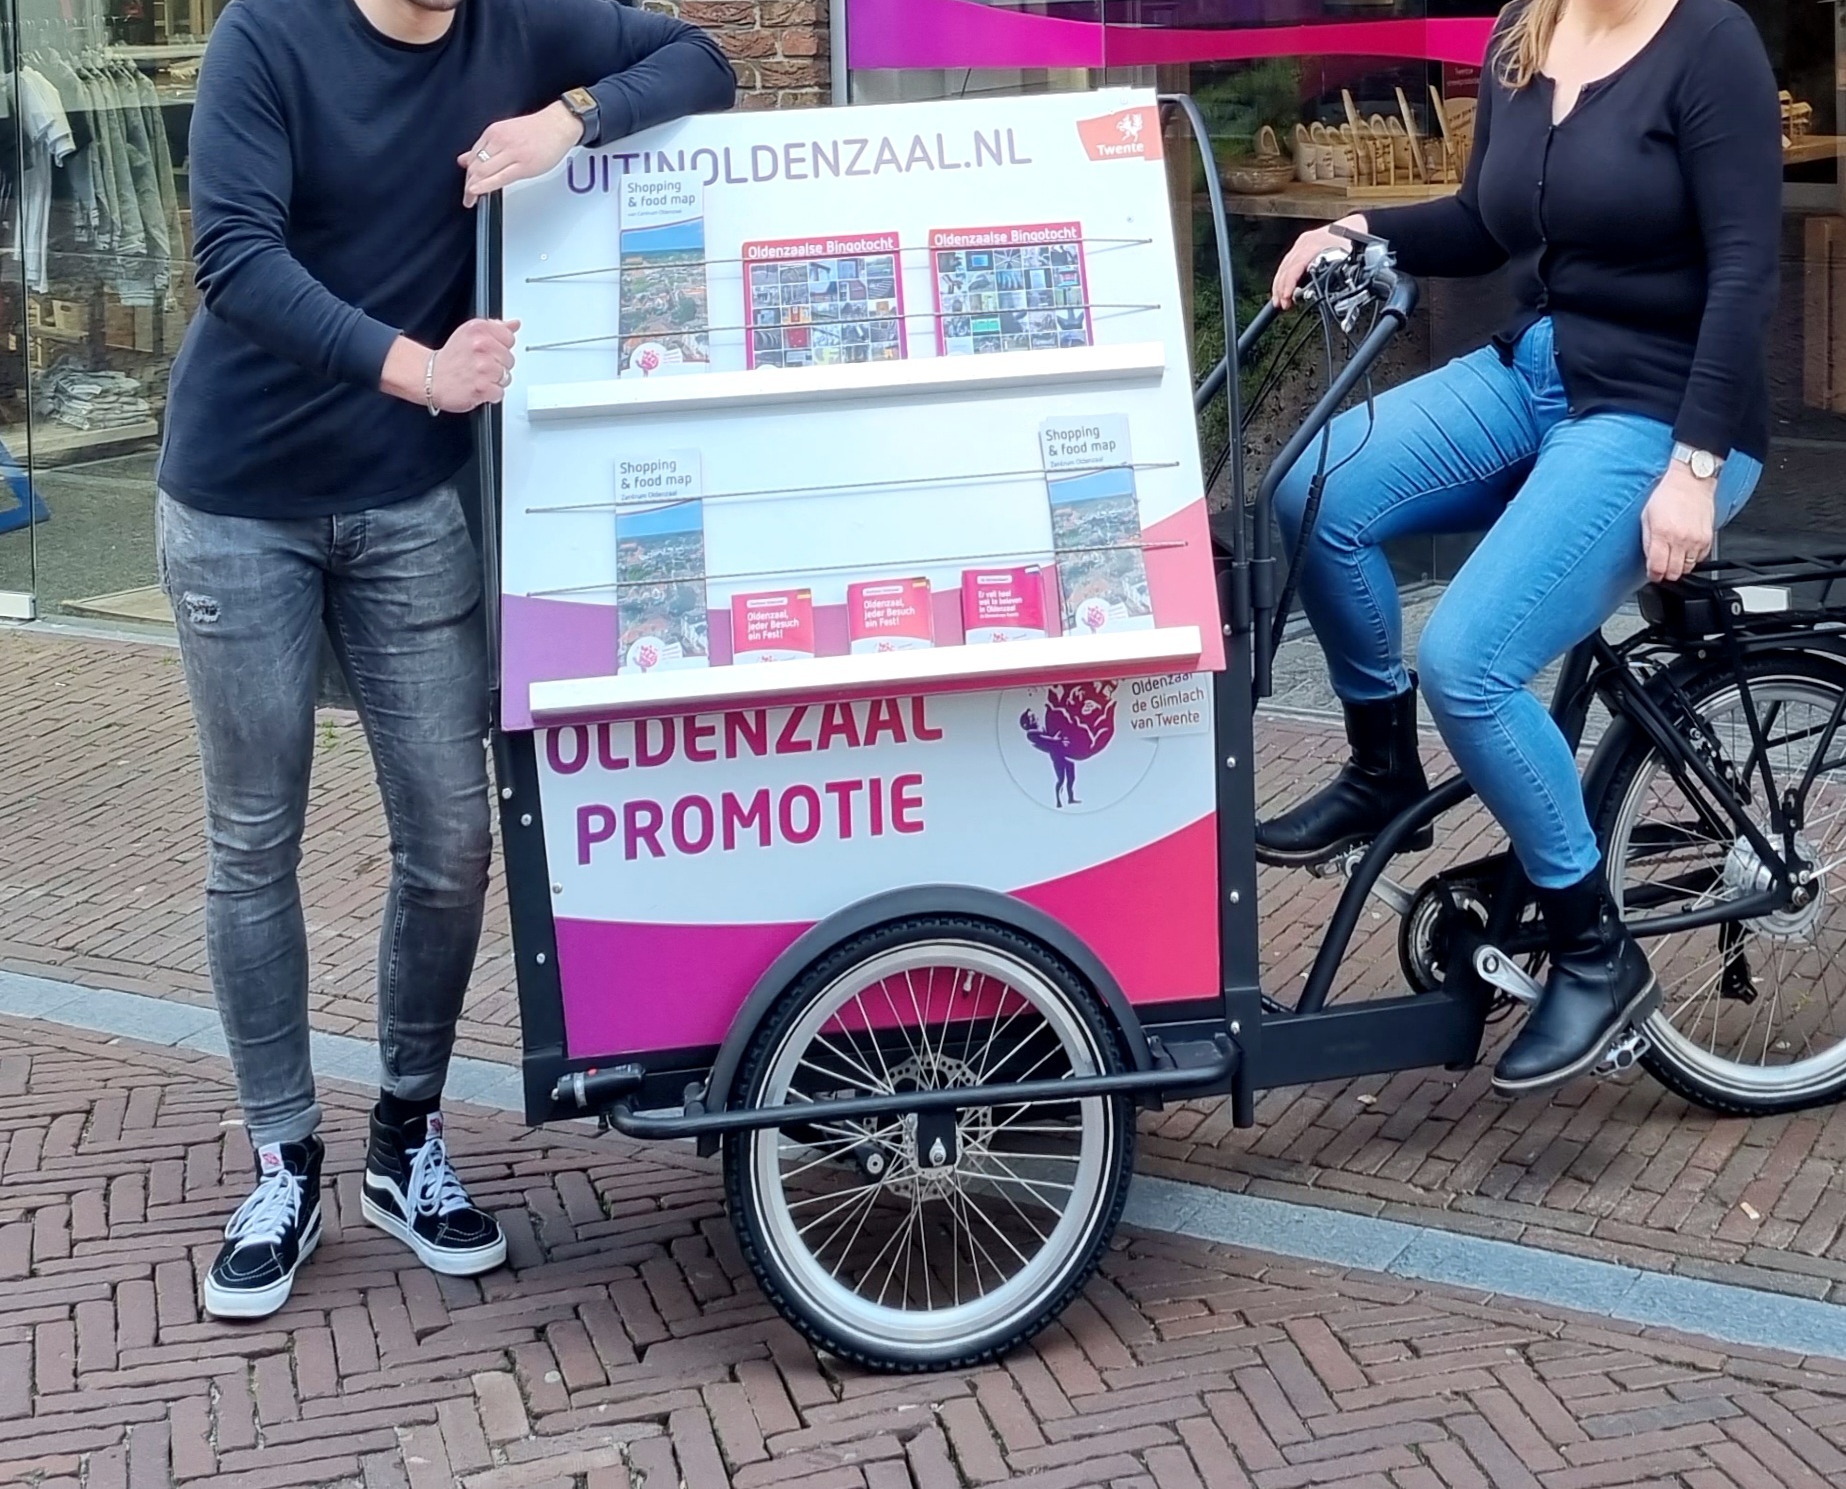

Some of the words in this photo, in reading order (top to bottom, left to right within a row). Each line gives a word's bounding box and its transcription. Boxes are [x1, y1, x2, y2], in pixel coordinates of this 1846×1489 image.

[1097, 141, 1145, 156] Twente
[627, 180, 681, 195] Shopping
[641, 193, 667, 207] food
[671, 194, 696, 207] map
[934, 227, 1010, 248] Oldenzaalse
[1011, 224, 1078, 245] Bingotocht
[747, 240, 823, 259] Oldenzaalse
[826, 236, 894, 256] Bingotocht
[1046, 426, 1100, 442] Shopping
[1061, 442, 1087, 455] food
[1091, 440, 1117, 452] map
[620, 459, 677, 475] Shopping
[635, 474, 662, 488] food
[666, 475, 693, 487] map
[1132, 699, 1147, 713] de
[1150, 687, 1205, 710] Glimlach
[1131, 717, 1154, 730] van
[1155, 711, 1200, 727] Twente
[576, 773, 925, 866] PROMOTIE
